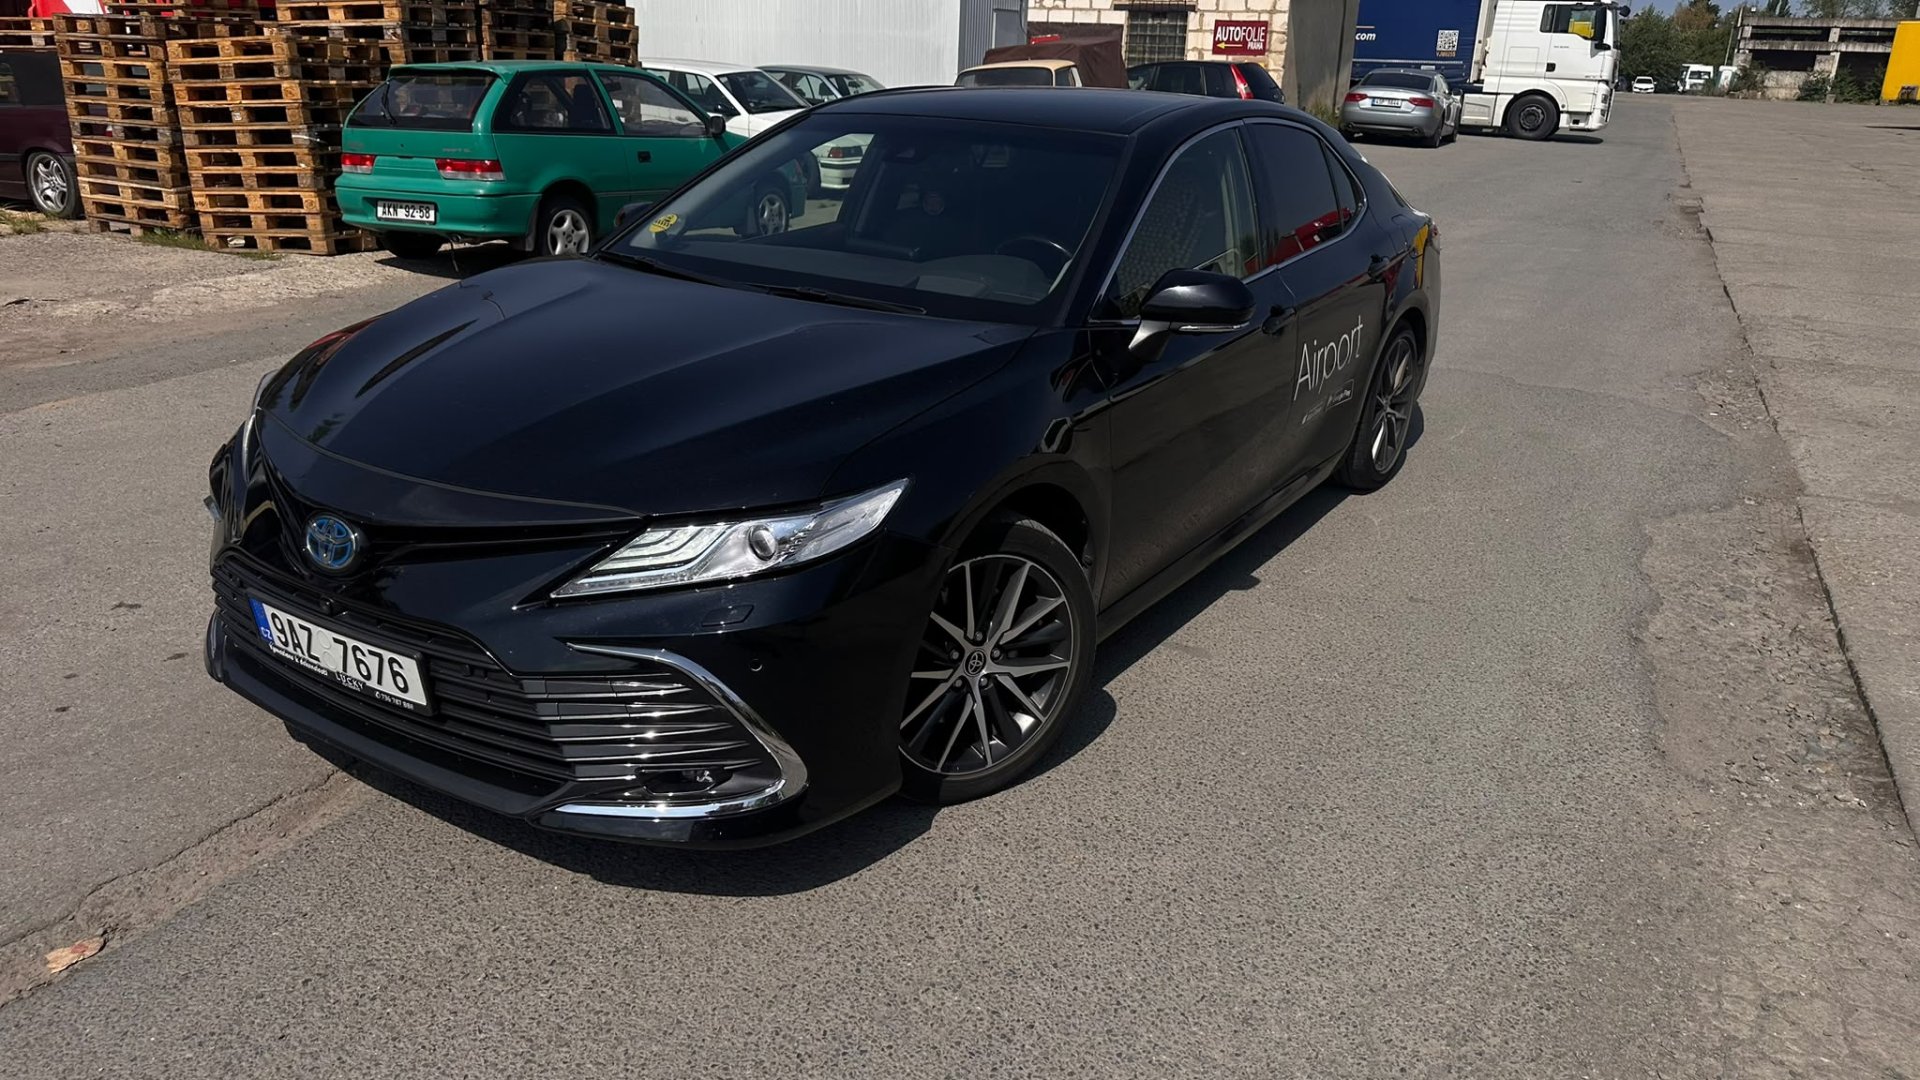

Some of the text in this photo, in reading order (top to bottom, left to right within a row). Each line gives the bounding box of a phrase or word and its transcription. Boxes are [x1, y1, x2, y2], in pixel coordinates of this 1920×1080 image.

[1215, 26, 1266, 42] AUTOFOLIE
[382, 202, 398, 217] AKN
[1294, 315, 1363, 401] Airport
[260, 627, 273, 639] CZ
[270, 612, 409, 694] 9AZ 7676
[335, 671, 364, 690] LUCKY
